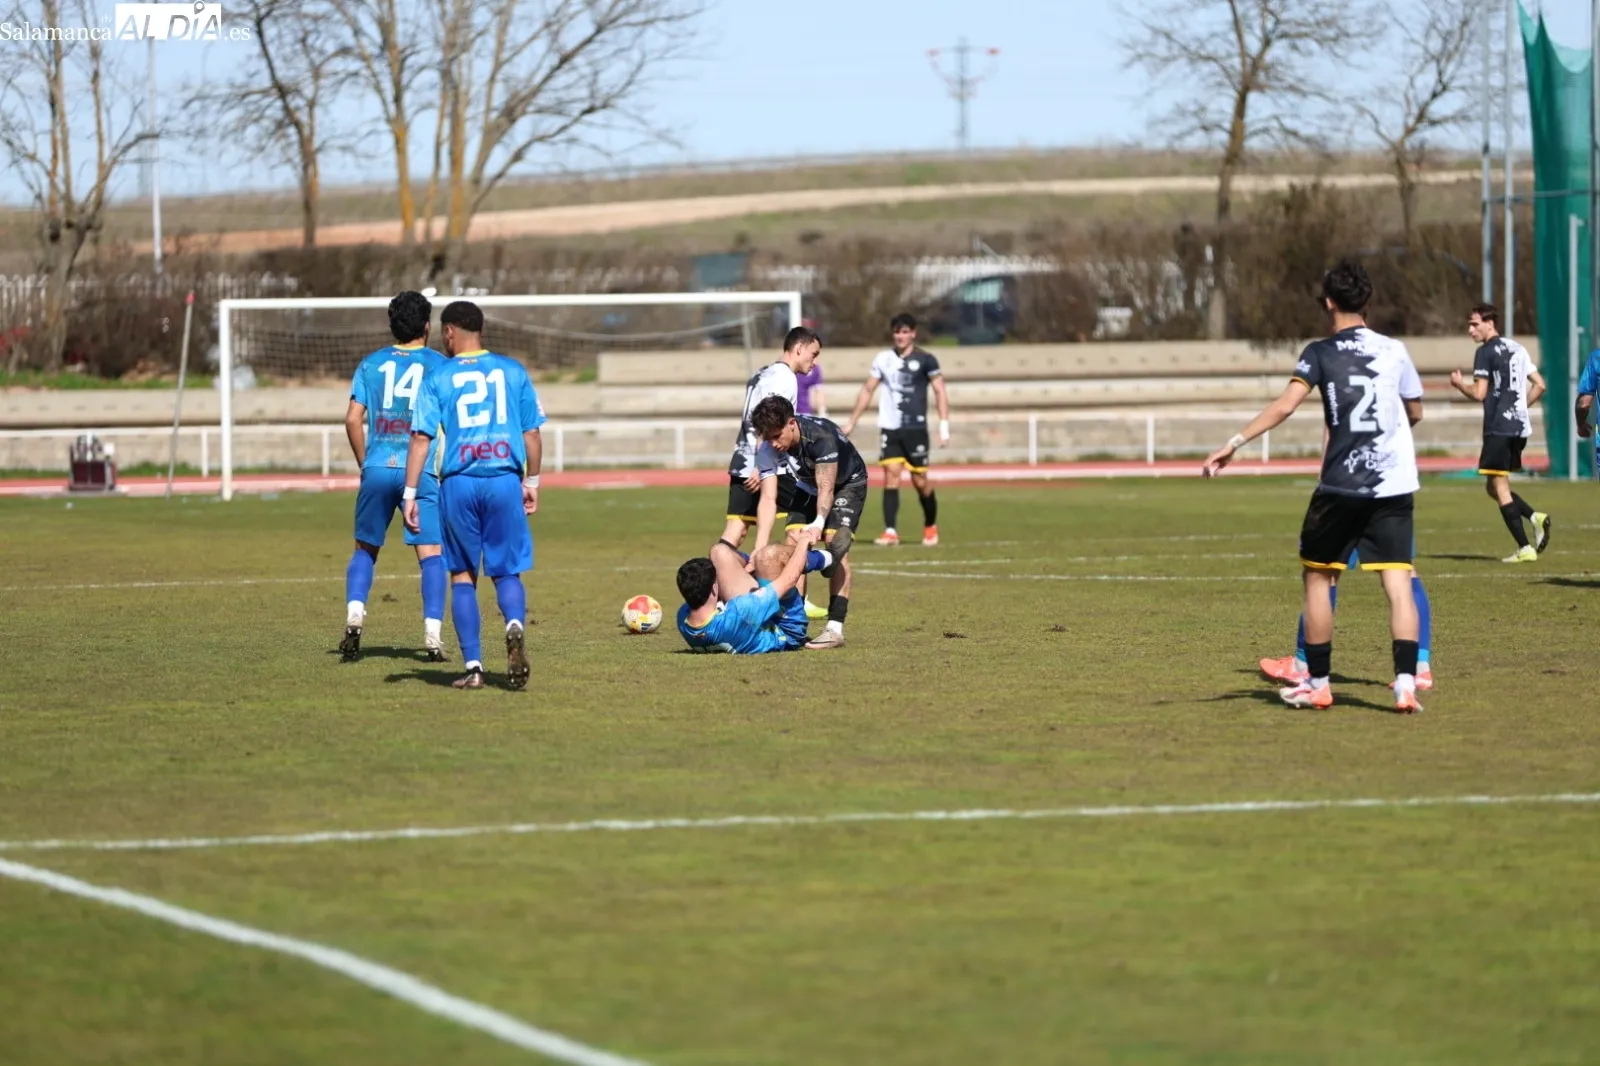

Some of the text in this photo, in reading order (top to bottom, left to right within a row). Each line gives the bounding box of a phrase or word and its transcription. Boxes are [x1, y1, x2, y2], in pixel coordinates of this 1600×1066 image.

[378, 360, 424, 410] 14
[452, 369, 508, 428] 21
[1348, 375, 1377, 432] 2
[459, 440, 511, 464] neo
